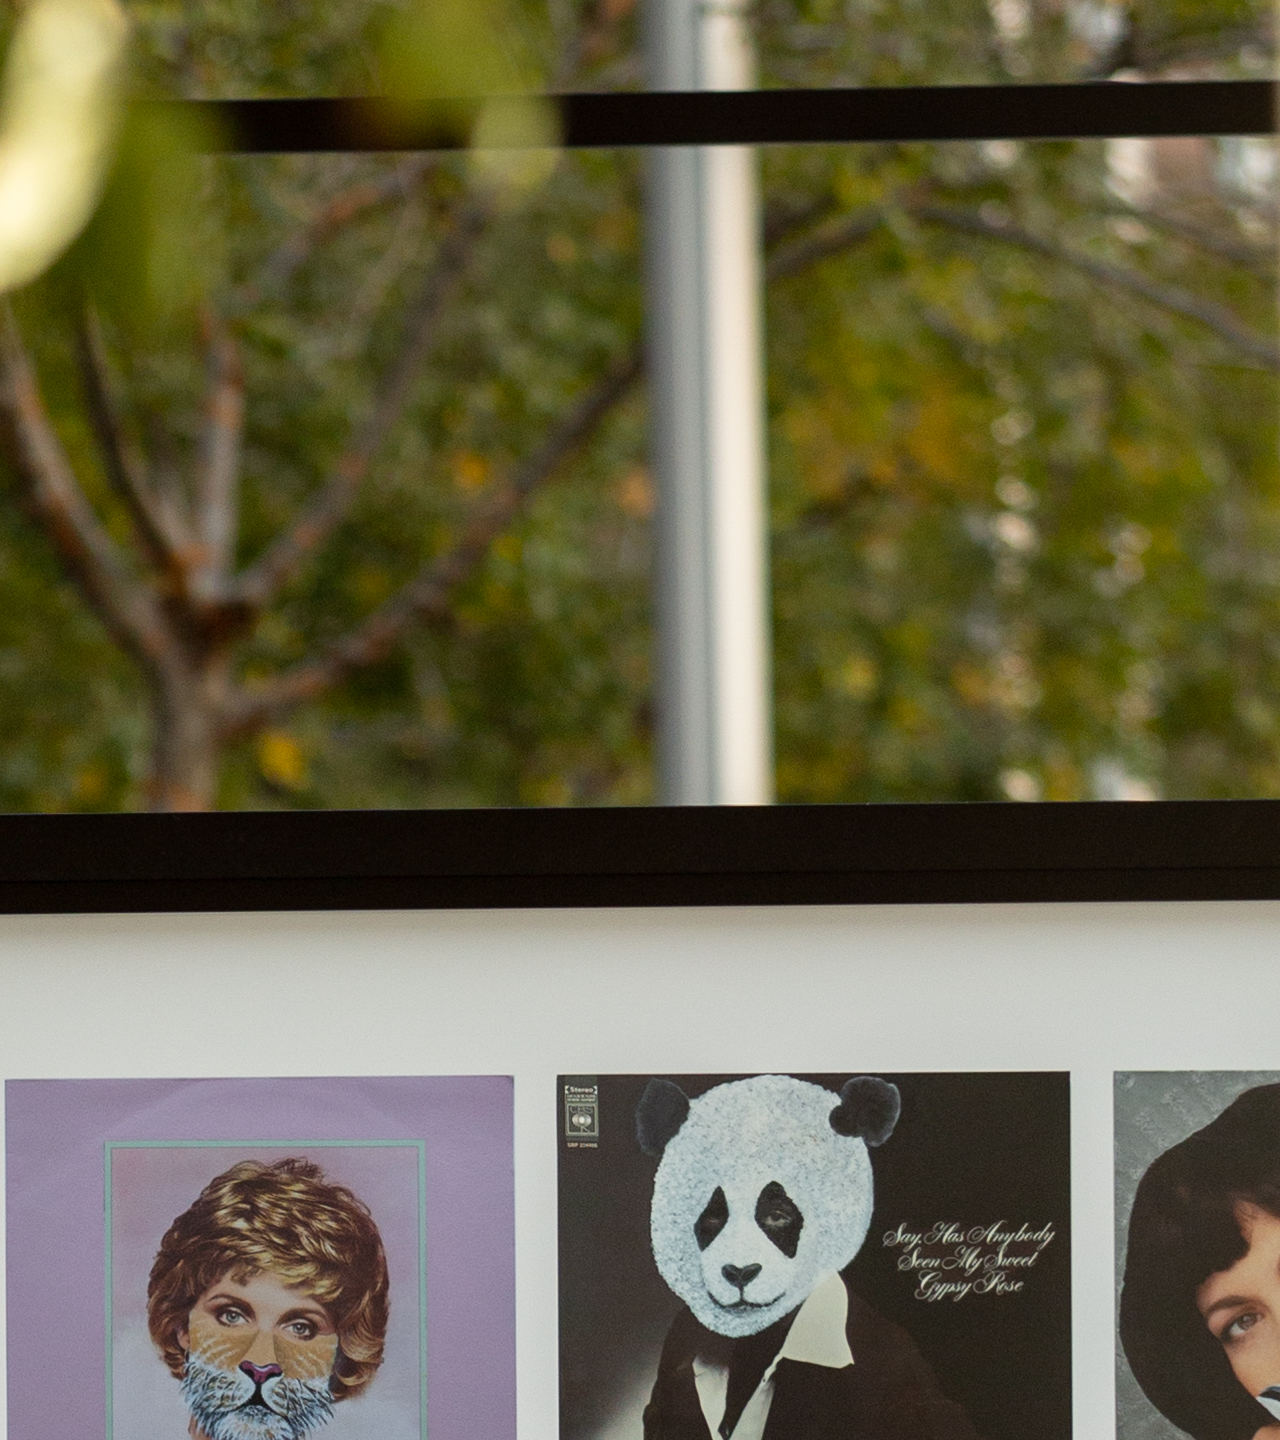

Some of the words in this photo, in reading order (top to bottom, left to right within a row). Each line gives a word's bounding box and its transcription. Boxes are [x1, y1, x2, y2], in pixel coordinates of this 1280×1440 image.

[923, 1221, 965, 1245] Has
[966, 1220, 1055, 1251] Anybody
[897, 1247, 941, 1271] Seen
[941, 1245, 984, 1277] My
[984, 1245, 1039, 1270] Sweet
[914, 1269, 972, 1302] Gypsy
[973, 1269, 1024, 1296] Rose
